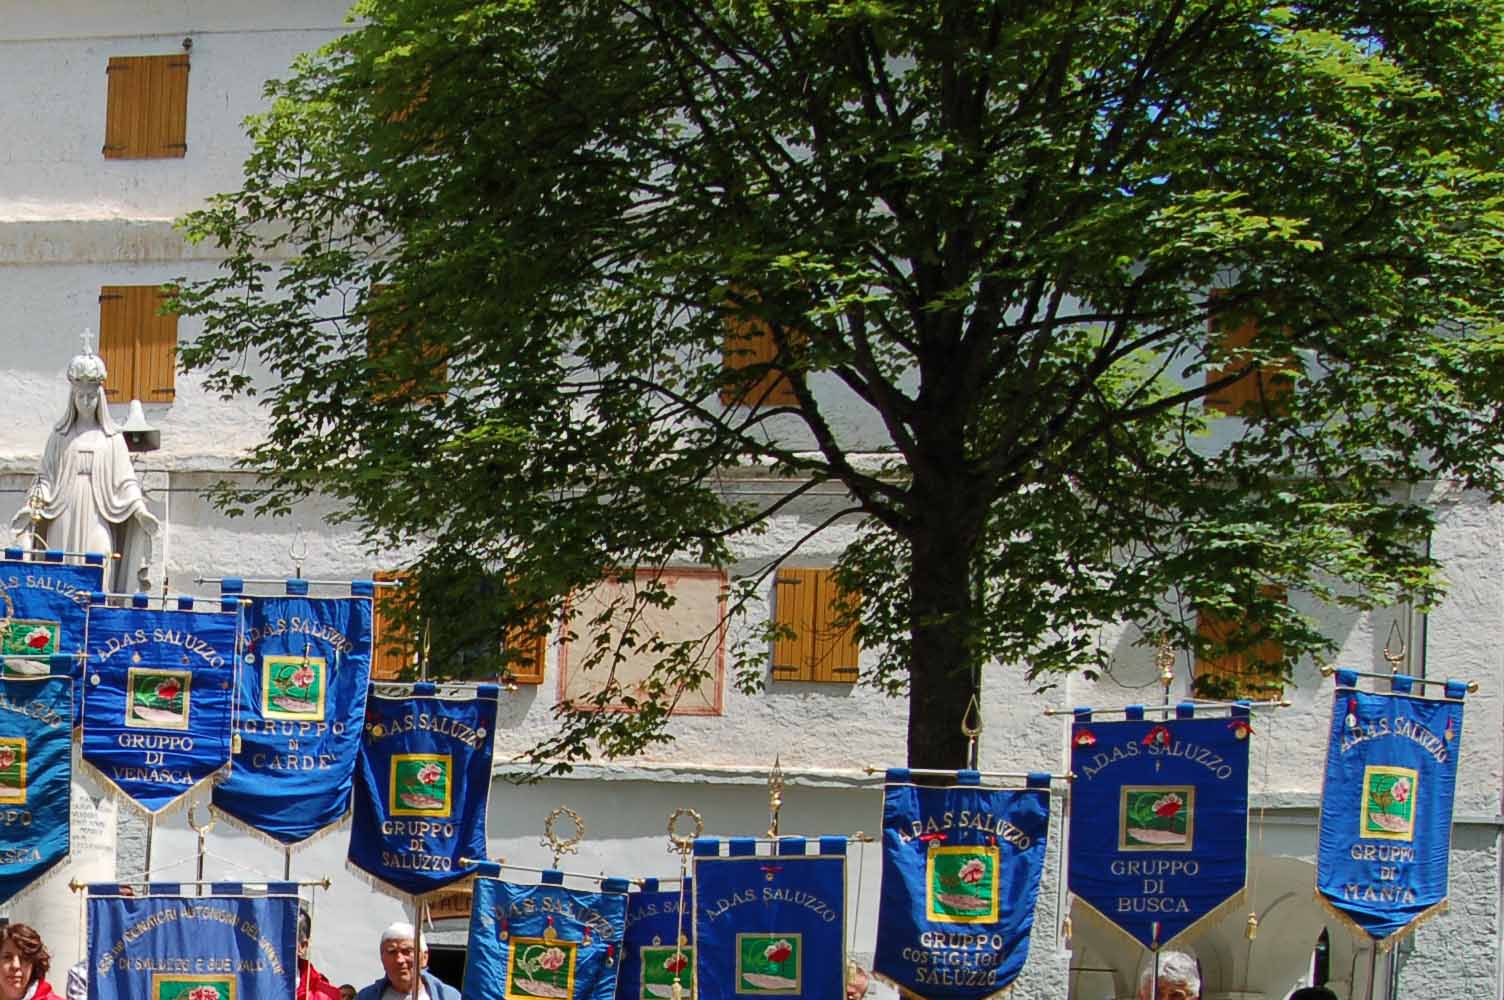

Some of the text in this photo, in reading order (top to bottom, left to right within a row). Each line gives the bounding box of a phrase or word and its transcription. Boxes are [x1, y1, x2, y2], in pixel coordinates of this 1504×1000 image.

[290, 616, 353, 655] SALUZZO
[153, 627, 226, 670] SALUZZO
[244, 719, 346, 736] GRUPPO
[118, 733, 194, 752] GRUPPO
[287, 738, 299, 751] DI
[1394, 716, 1448, 764] SALUZZO
[144, 752, 166, 766] DI
[1147, 740, 1233, 780] SALUZZO
[111, 767, 196, 786] VENASCA
[381, 820, 455, 837] GRUPPO
[958, 809, 1031, 850] SALUZZO
[410, 838, 425, 852] DI
[1350, 844, 1416, 863] GRUPPO
[381, 852, 453, 871] SALUZZO
[1110, 859, 1199, 877] GRUPPO
[1378, 866, 1396, 880] DI
[1143, 879, 1165, 894] DI
[1343, 884, 1417, 904] MANTA
[761, 886, 837, 924] SALUZZO
[1117, 896, 1191, 913] BUSCA
[920, 931, 1004, 951] GRUPPO
[915, 966, 998, 987] SALUZZO
